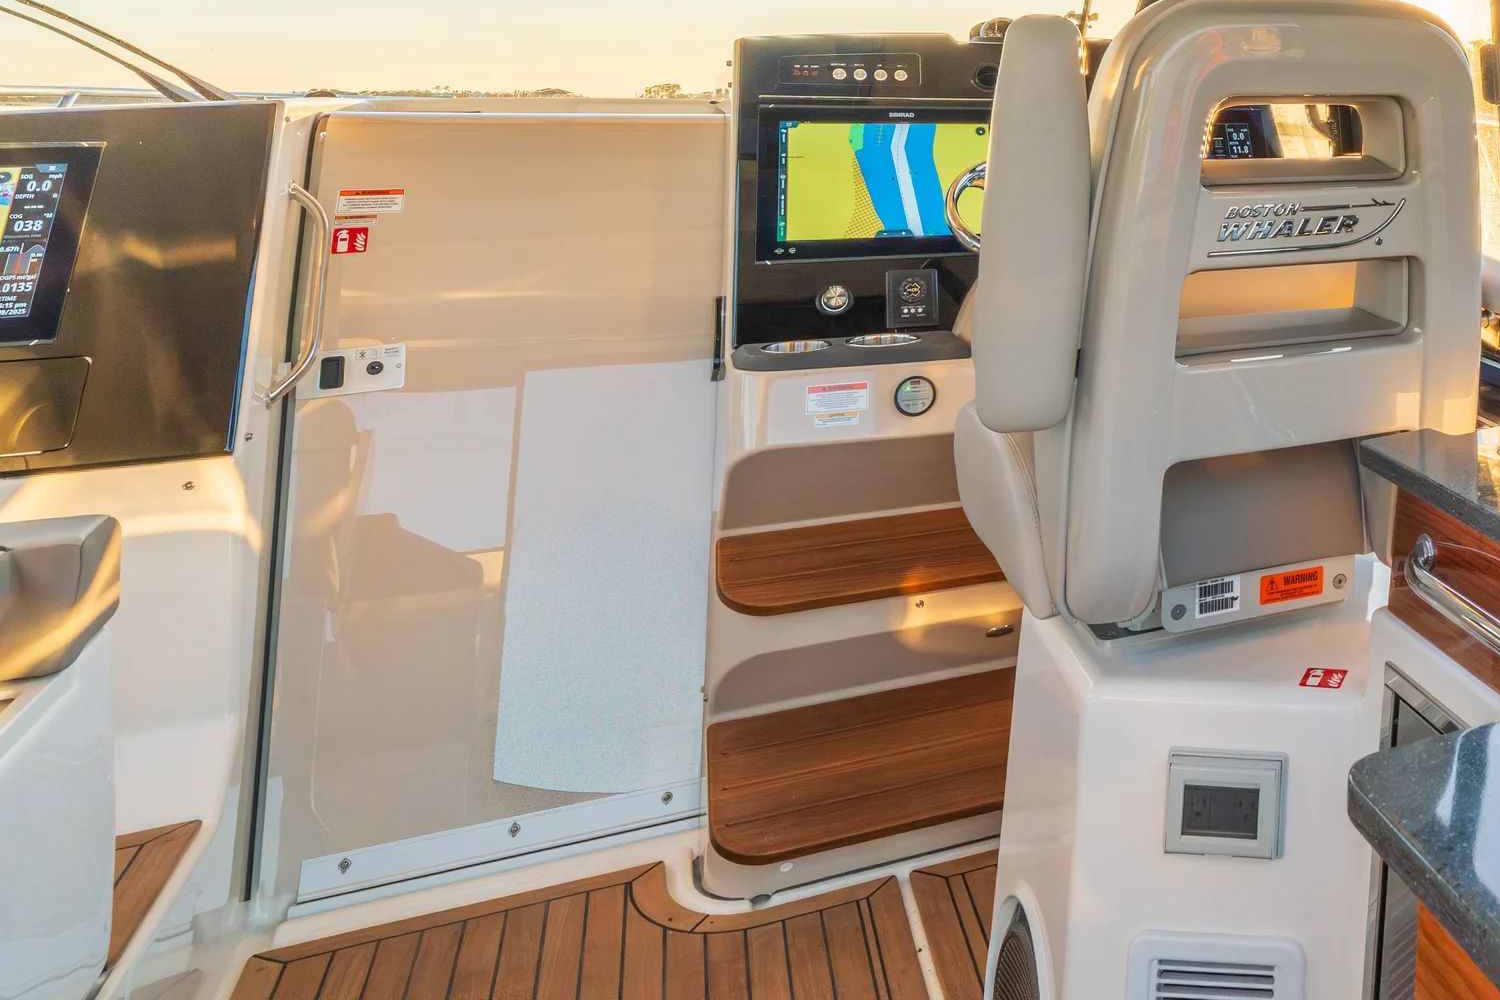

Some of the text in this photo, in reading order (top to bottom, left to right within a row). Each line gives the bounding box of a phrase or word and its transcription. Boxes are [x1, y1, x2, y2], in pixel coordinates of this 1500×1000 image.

[1232, 132, 1245, 140] 0.0
[1232, 145, 1249, 154] 11.8
[26, 180, 52, 192] 0.0
[1224, 202, 1301, 219] BOSTON
[13, 219, 43, 232] 038
[1217, 214, 1359, 242] WHALER
[1283, 570, 1318, 586] WARNING
